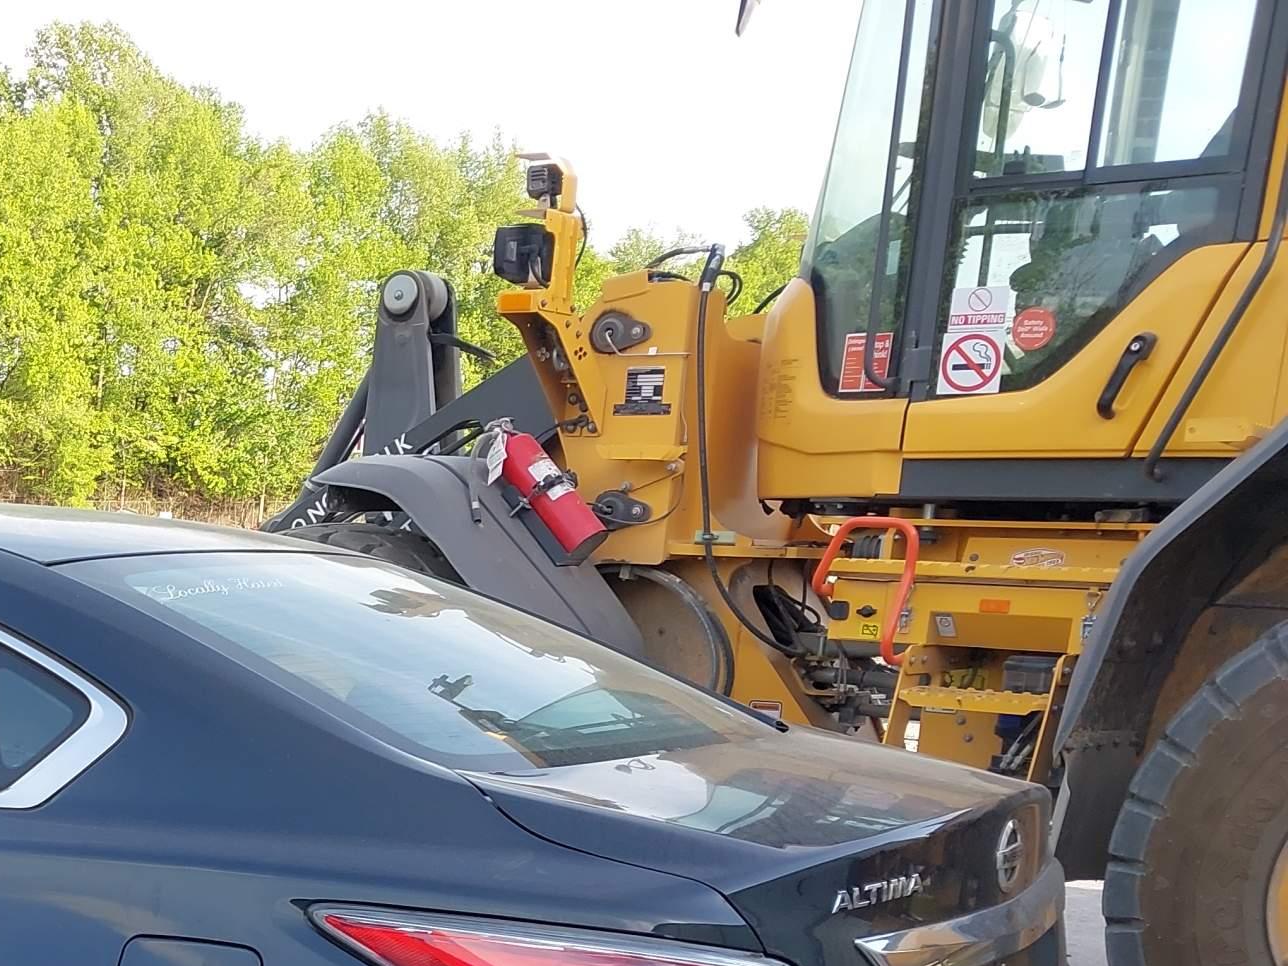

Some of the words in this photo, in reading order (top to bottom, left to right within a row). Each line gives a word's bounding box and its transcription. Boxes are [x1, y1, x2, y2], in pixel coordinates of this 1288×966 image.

[951, 315, 966, 325] NO
[967, 314, 1004, 325] TIPPING
[152, 578, 229, 601] Locally
[831, 872, 924, 914] ALTIMA
